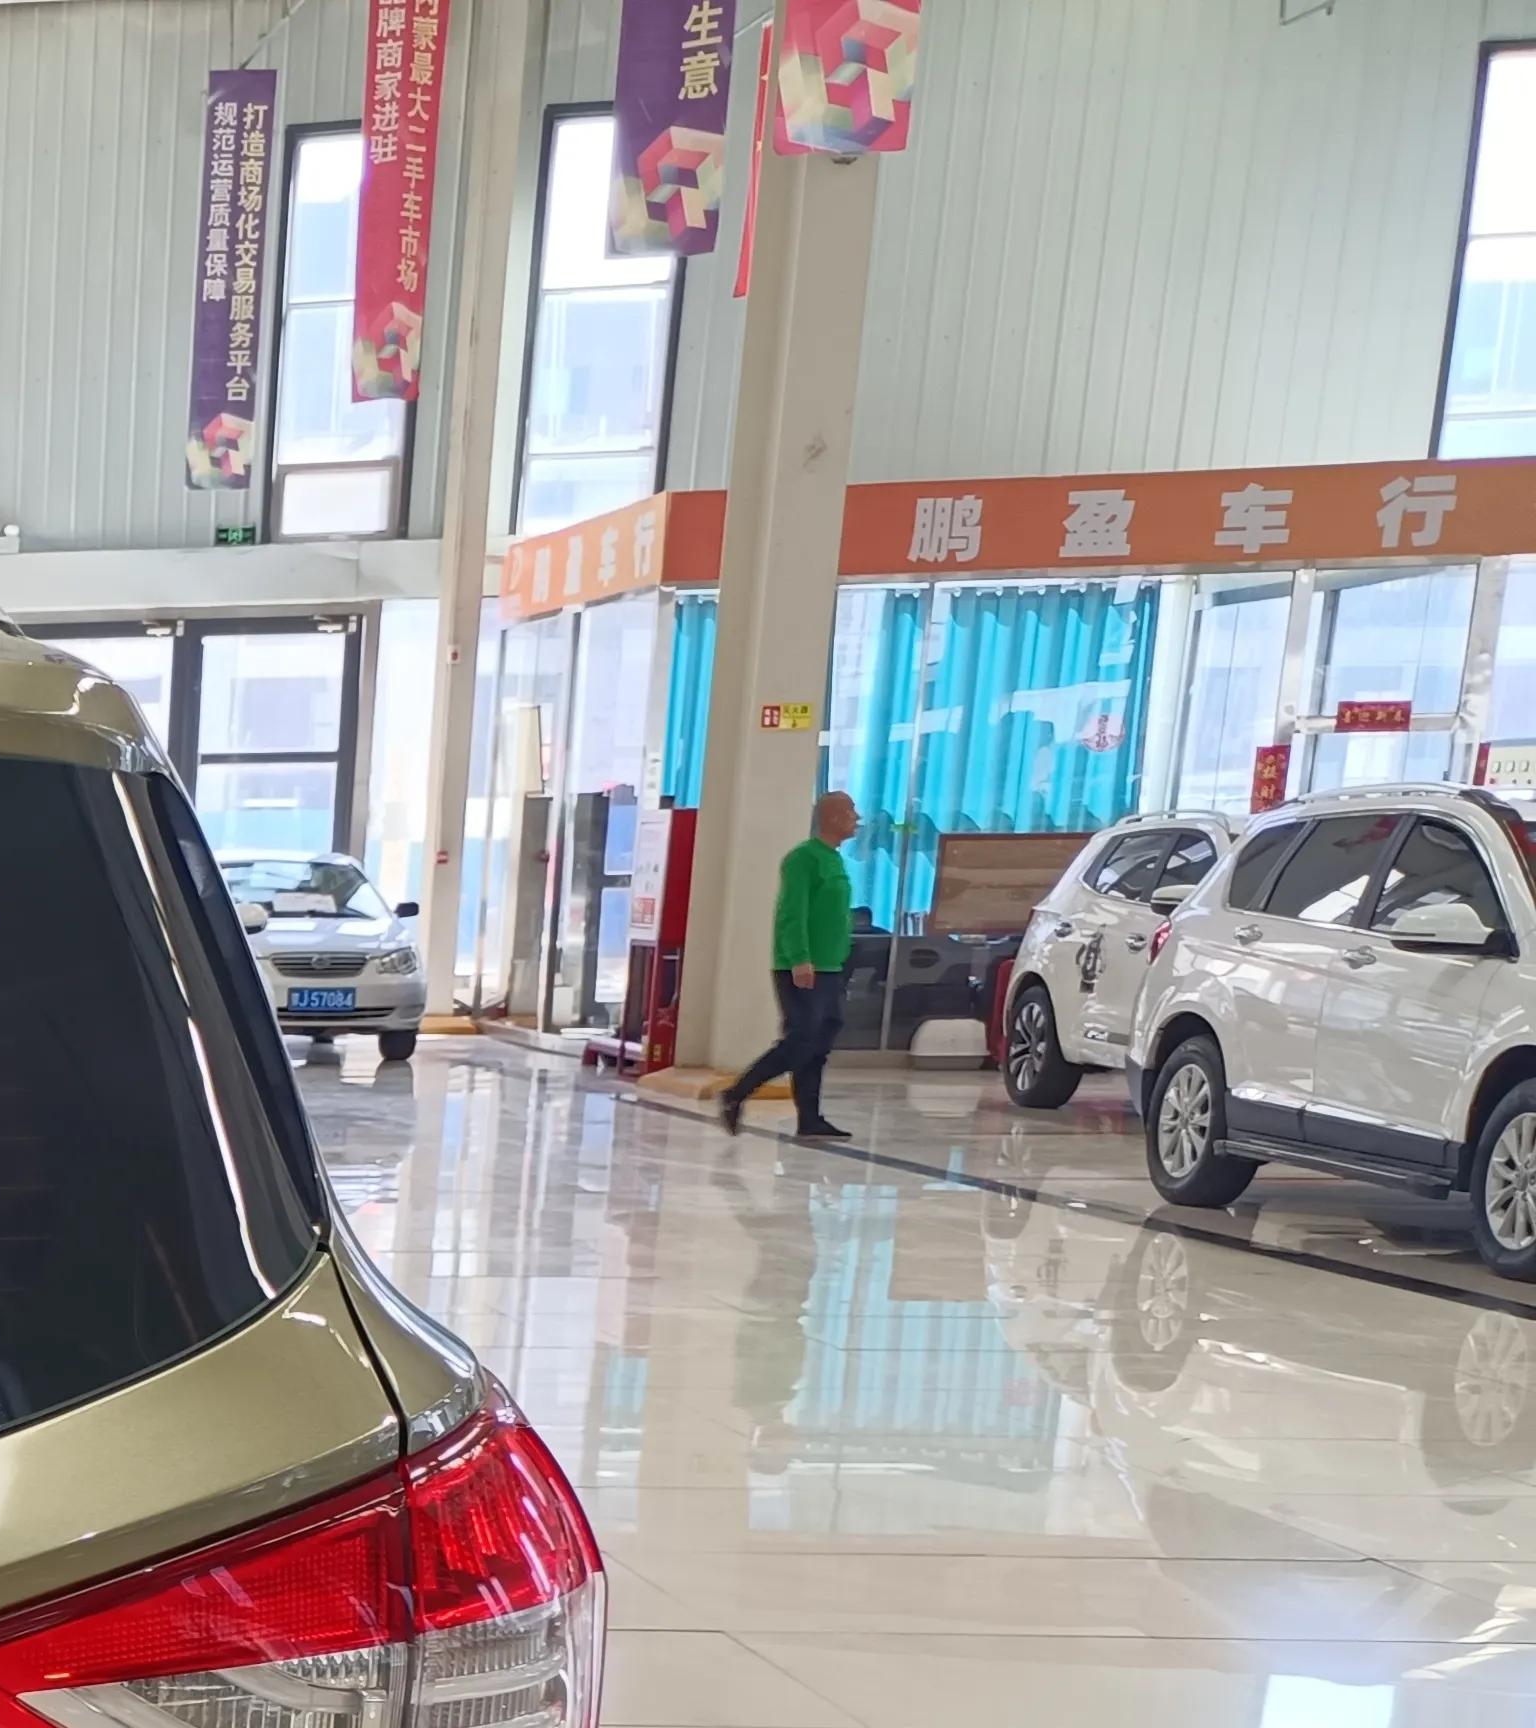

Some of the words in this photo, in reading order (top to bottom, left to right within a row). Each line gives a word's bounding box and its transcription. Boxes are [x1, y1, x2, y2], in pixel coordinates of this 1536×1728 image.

[369, 0, 406, 165] 牌商家进驻
[678, 1, 724, 101] 生意
[202, 102, 238, 302] 规范运营质量保障
[225, 102, 269, 401] 打造商场化交易服务平台
[908, 475, 1458, 563] 鹏盈车行
